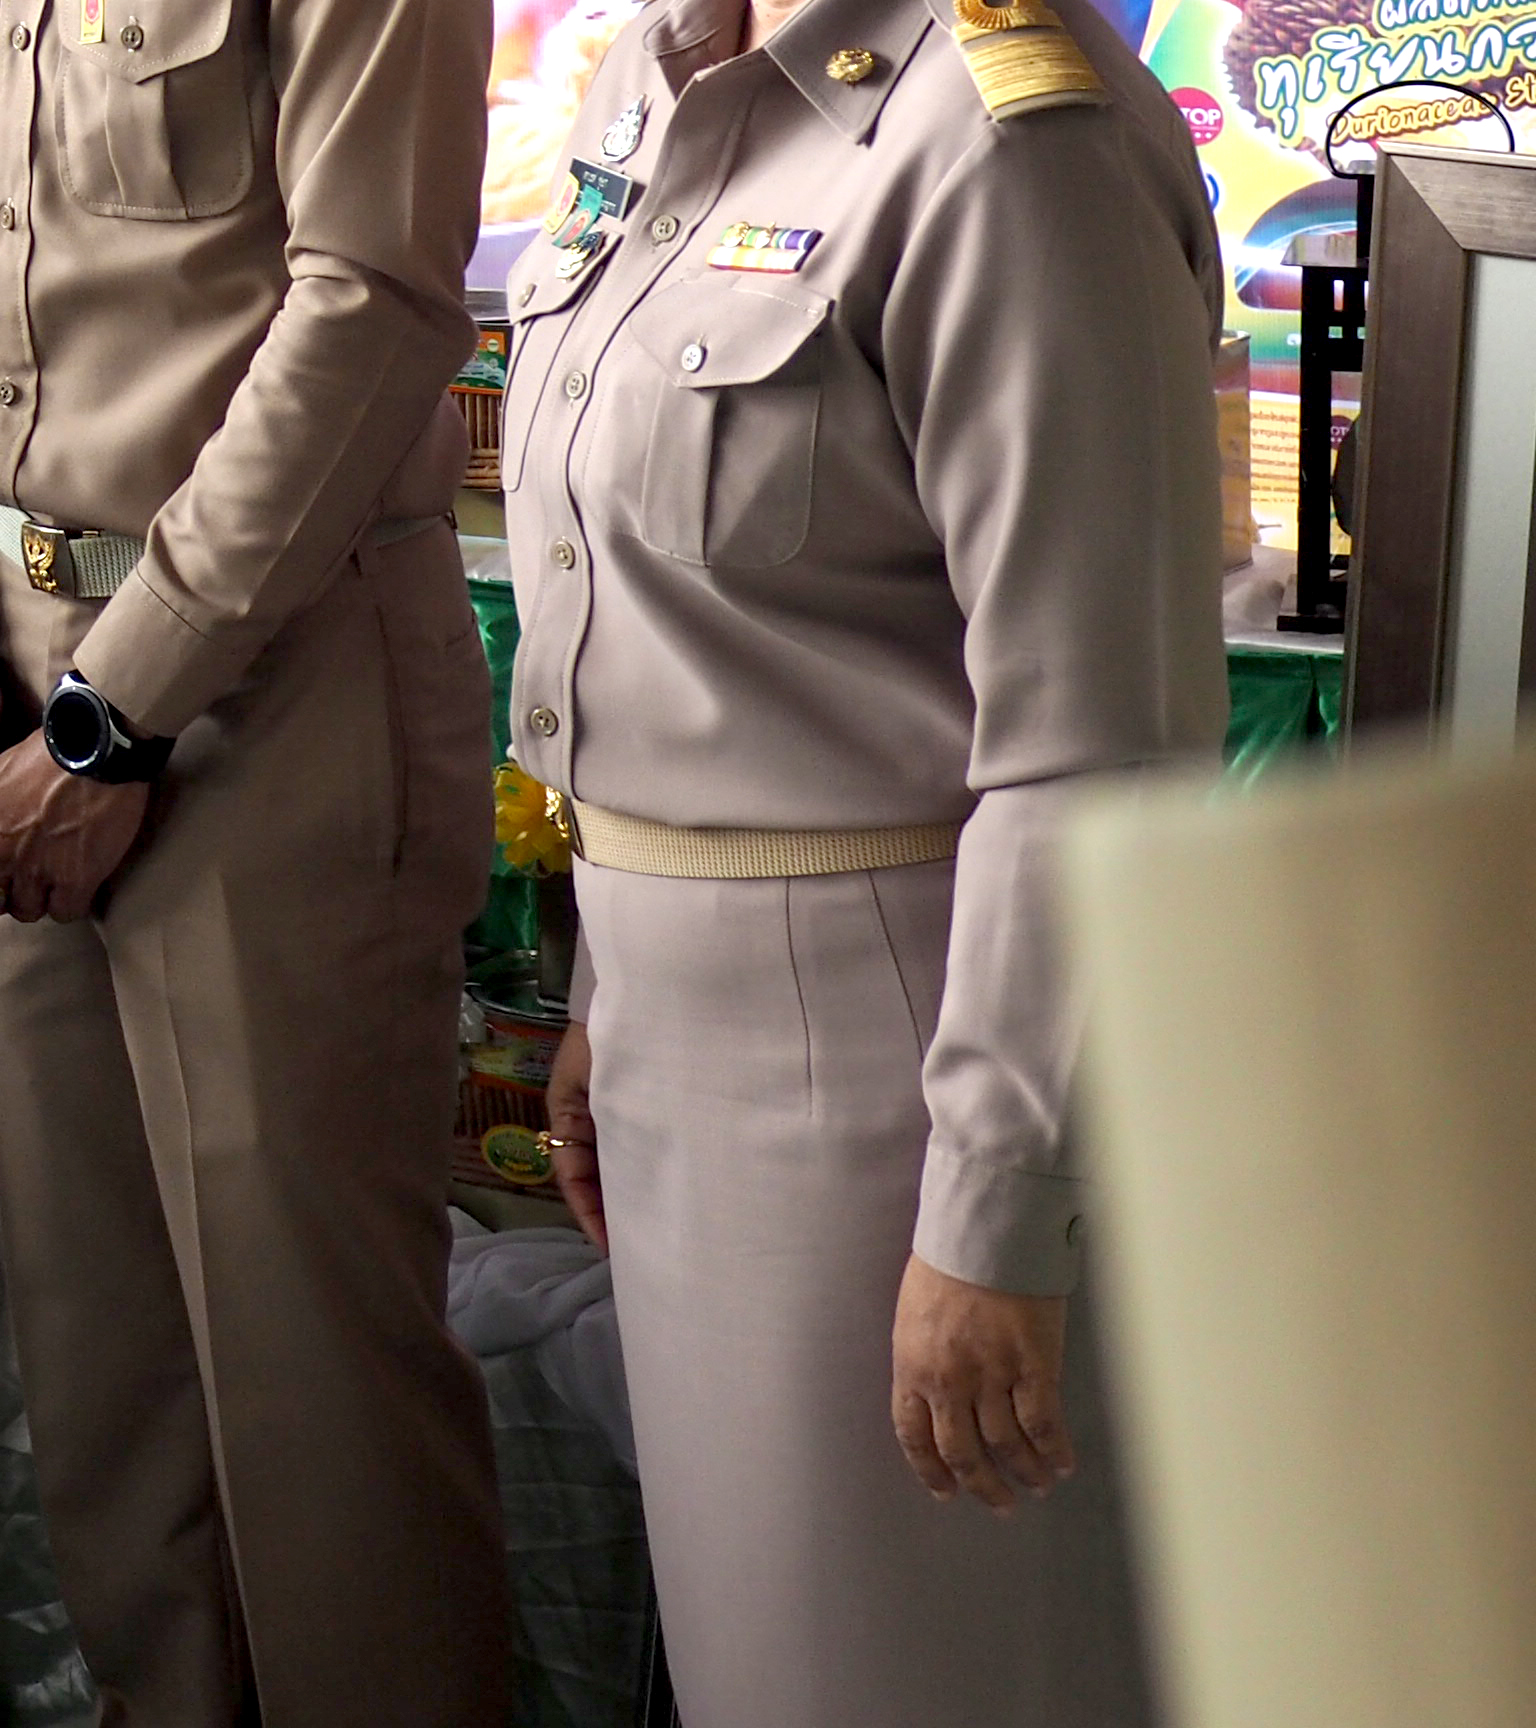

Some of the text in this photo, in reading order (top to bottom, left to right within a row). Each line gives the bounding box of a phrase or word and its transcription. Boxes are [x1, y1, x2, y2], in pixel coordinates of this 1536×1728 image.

[1256, 17, 1536, 142] ทุเรียนกว
[1505, 70, 1536, 110] St
[1176, 106, 1222, 129] TOP
